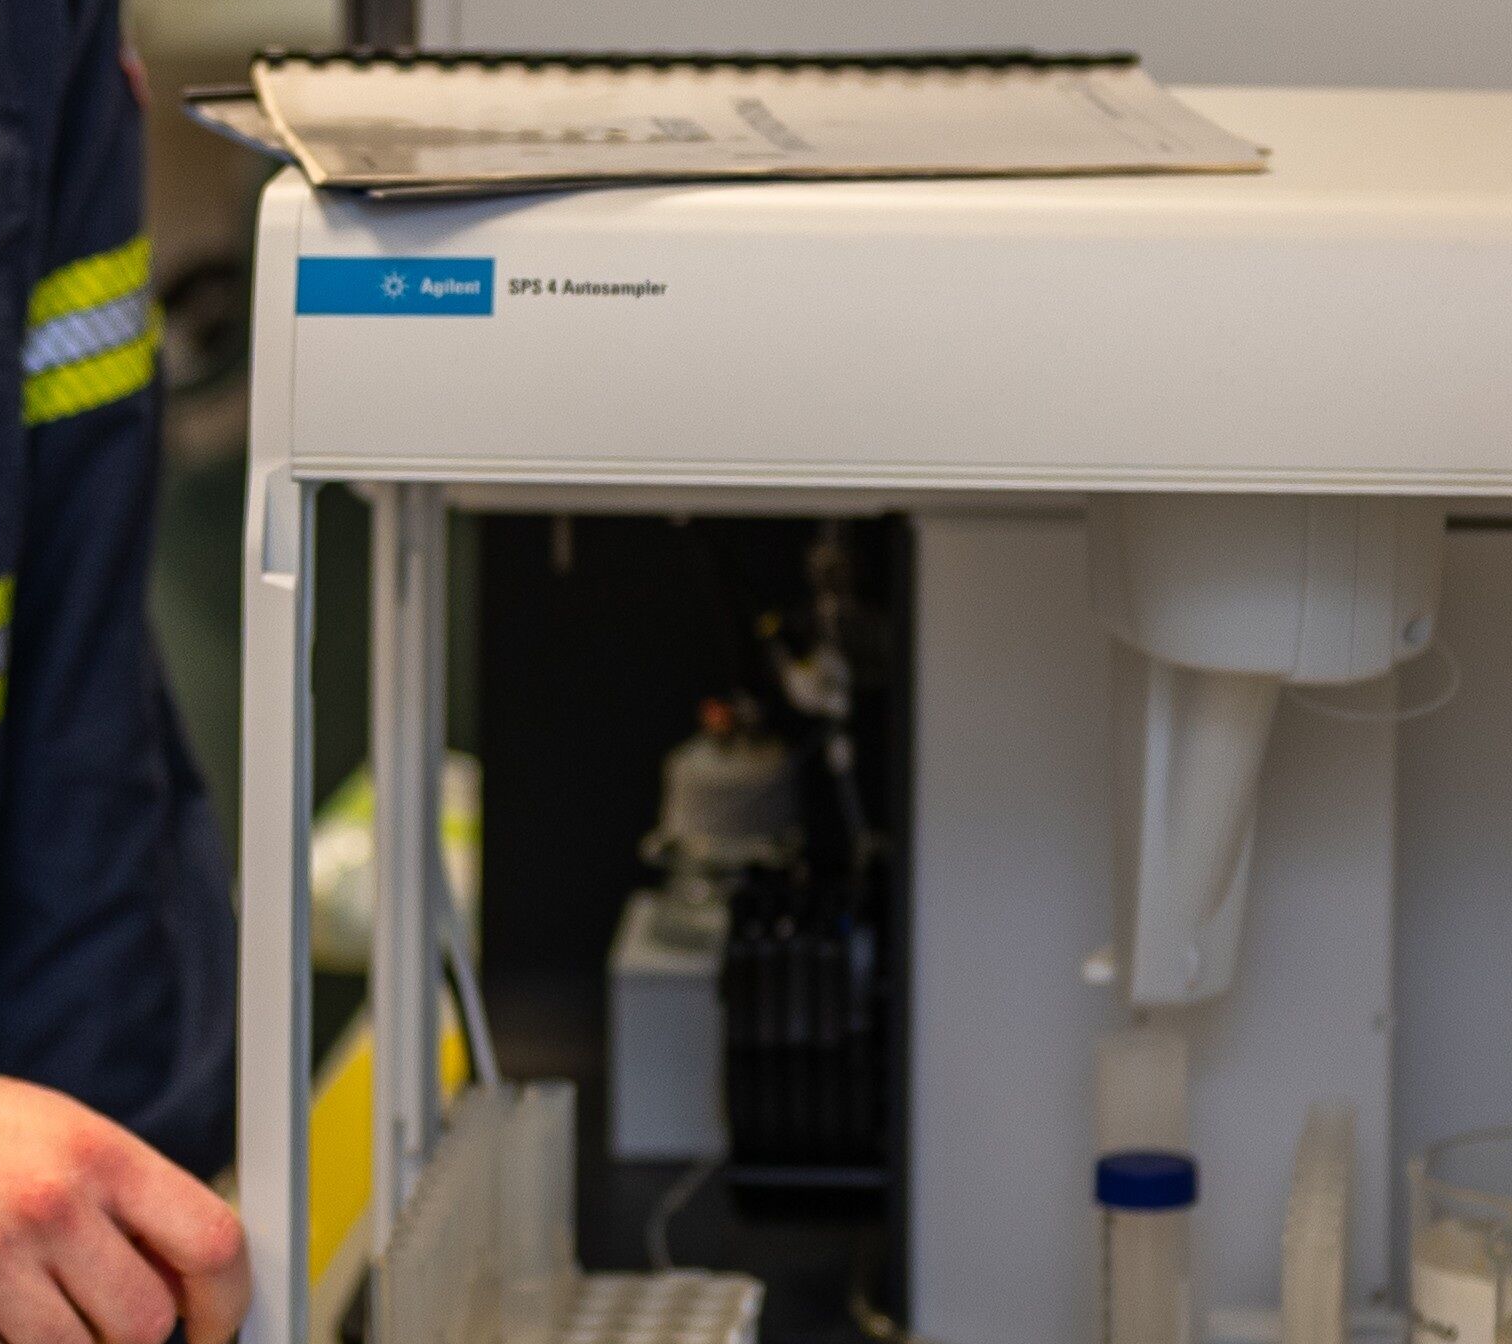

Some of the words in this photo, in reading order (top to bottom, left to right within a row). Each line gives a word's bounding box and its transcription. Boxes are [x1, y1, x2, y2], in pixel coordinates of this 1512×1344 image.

[419, 276, 481, 299] Agilent
[508, 277, 543, 296] SPS
[547, 277, 558, 296] 4
[562, 277, 669, 299] Autosampler
